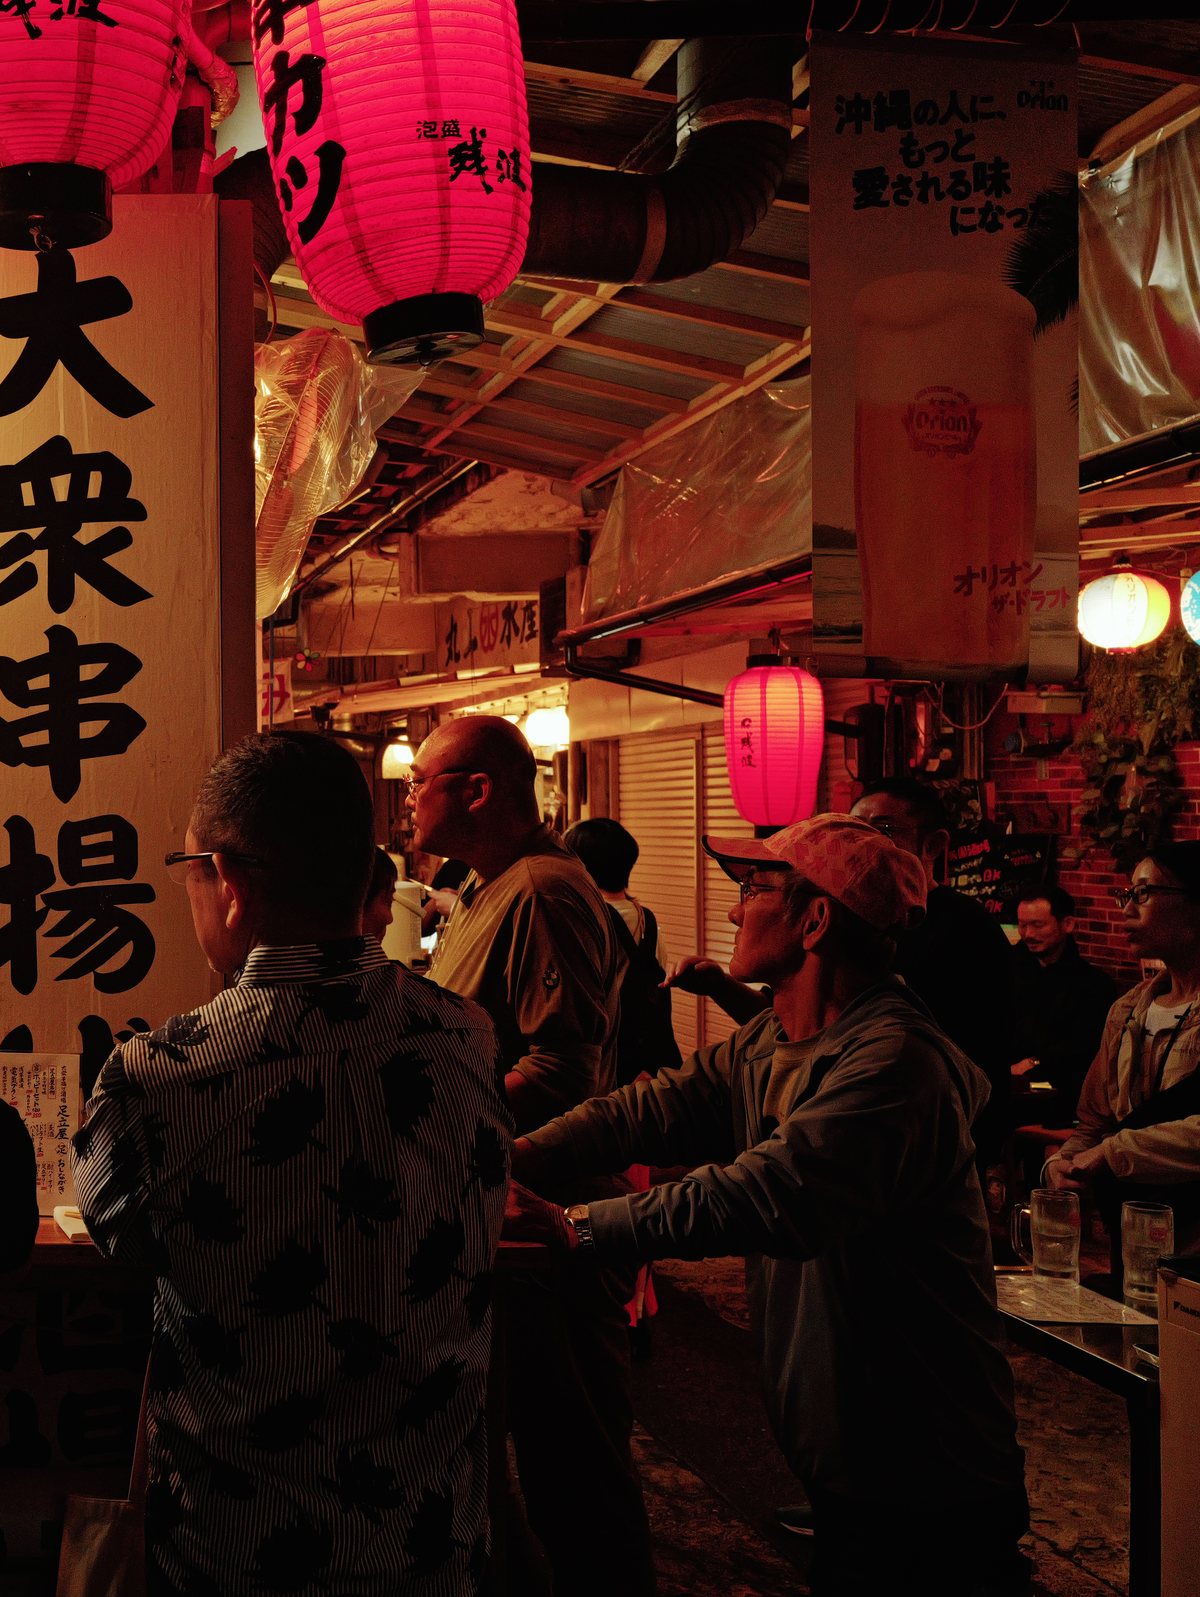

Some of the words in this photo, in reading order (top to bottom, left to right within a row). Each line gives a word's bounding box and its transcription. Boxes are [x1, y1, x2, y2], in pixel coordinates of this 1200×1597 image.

[1017, 90, 1069, 112] Orion
[416, 119, 462, 140] 泡盛
[448, 126, 527, 193] 残波
[899, 129, 976, 169] もっと
[852, 157, 1011, 210] 愛される味
[951, 202, 1049, 235] になった
[916, 411, 968, 432] Orion
[953, 560, 1043, 596] オリオン
[54, 1105, 71, 1140] 足立屋
